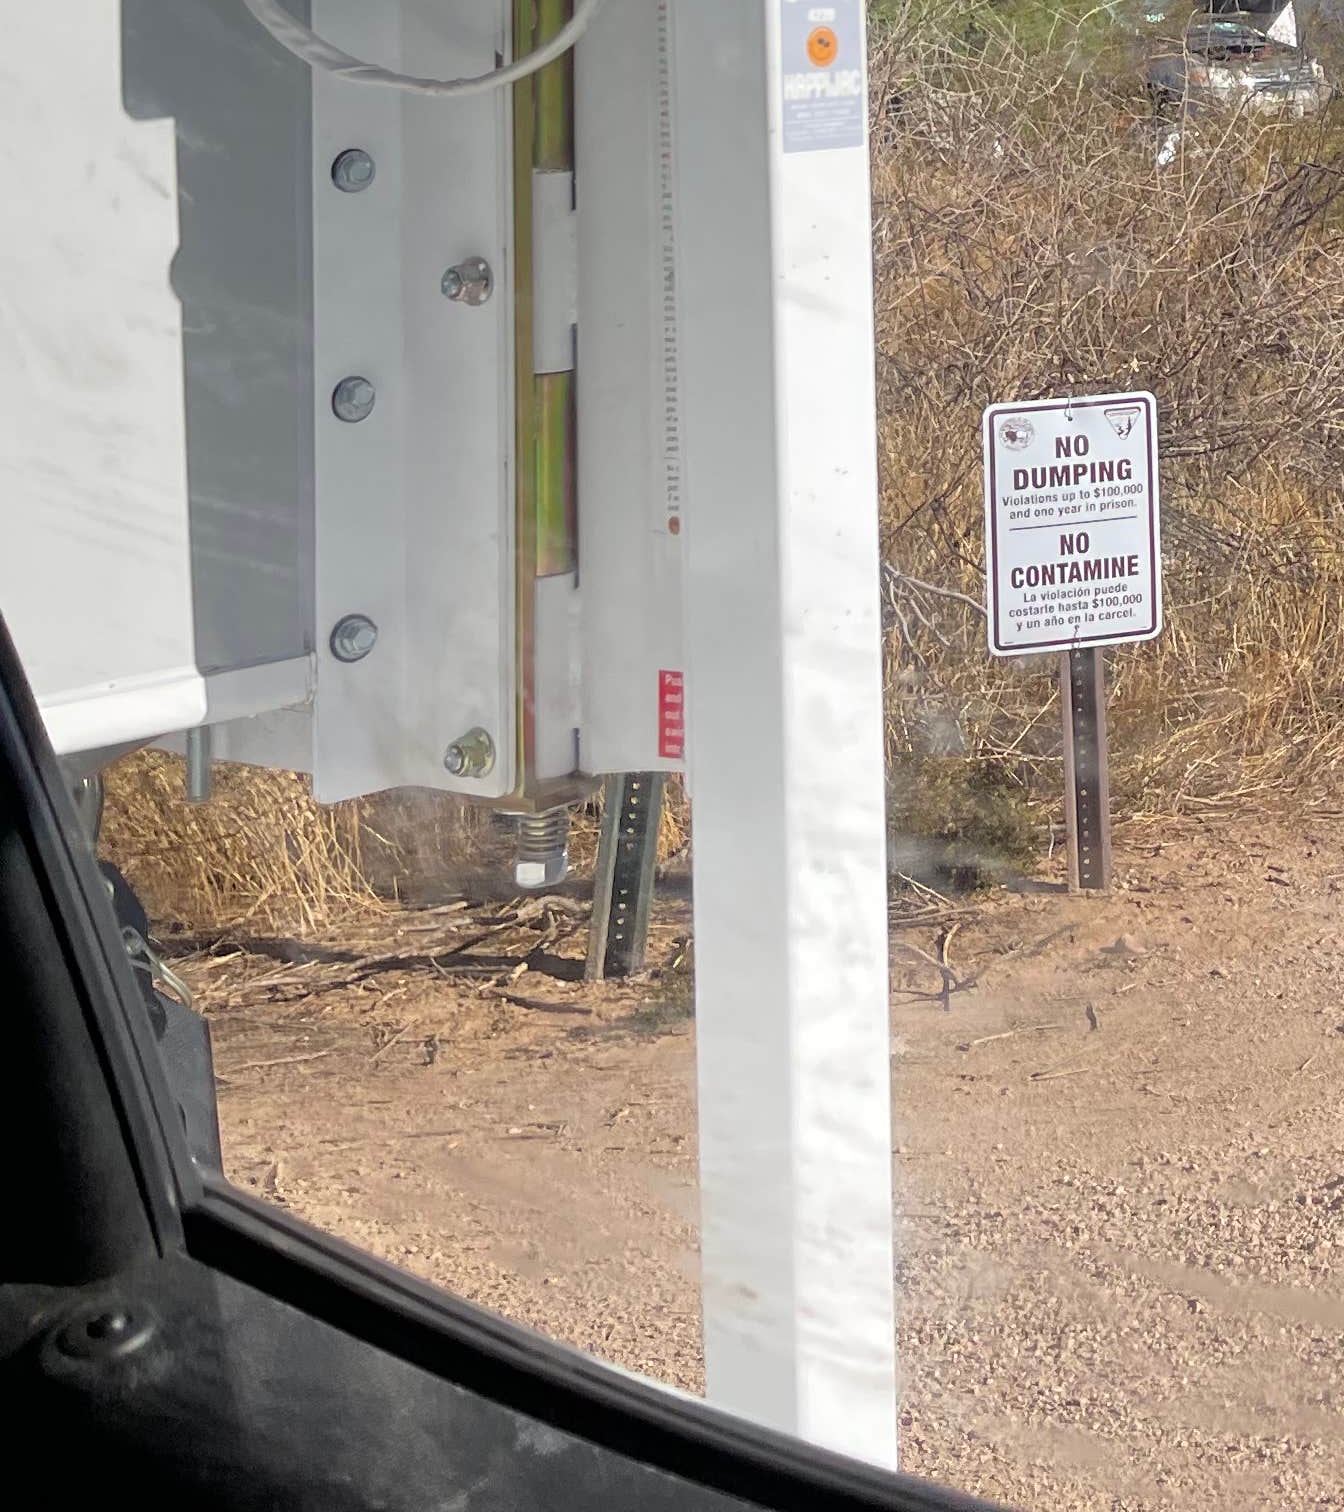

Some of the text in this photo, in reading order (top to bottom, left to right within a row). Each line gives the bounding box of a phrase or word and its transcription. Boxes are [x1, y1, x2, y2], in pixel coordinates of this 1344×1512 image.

[1055, 434, 1089, 458] NO
[1013, 458, 1132, 490] DUMPING
[1002, 483, 1143, 506] Violations up to $100,000
[1009, 498, 1137, 519] and one year in prison.
[1060, 532, 1090, 556] NO
[1011, 554, 1139, 589] CONTAMINE
[1023, 583, 1128, 603] La violación puede
[1009, 593, 1143, 618] costarle hasta $100,000
[1016, 622, 1023, 632] y
[1026, 619, 1041, 629] un
[1044, 615, 1065, 627] año
[1068, 615, 1081, 624] en
[1085, 612, 1095, 622] la
